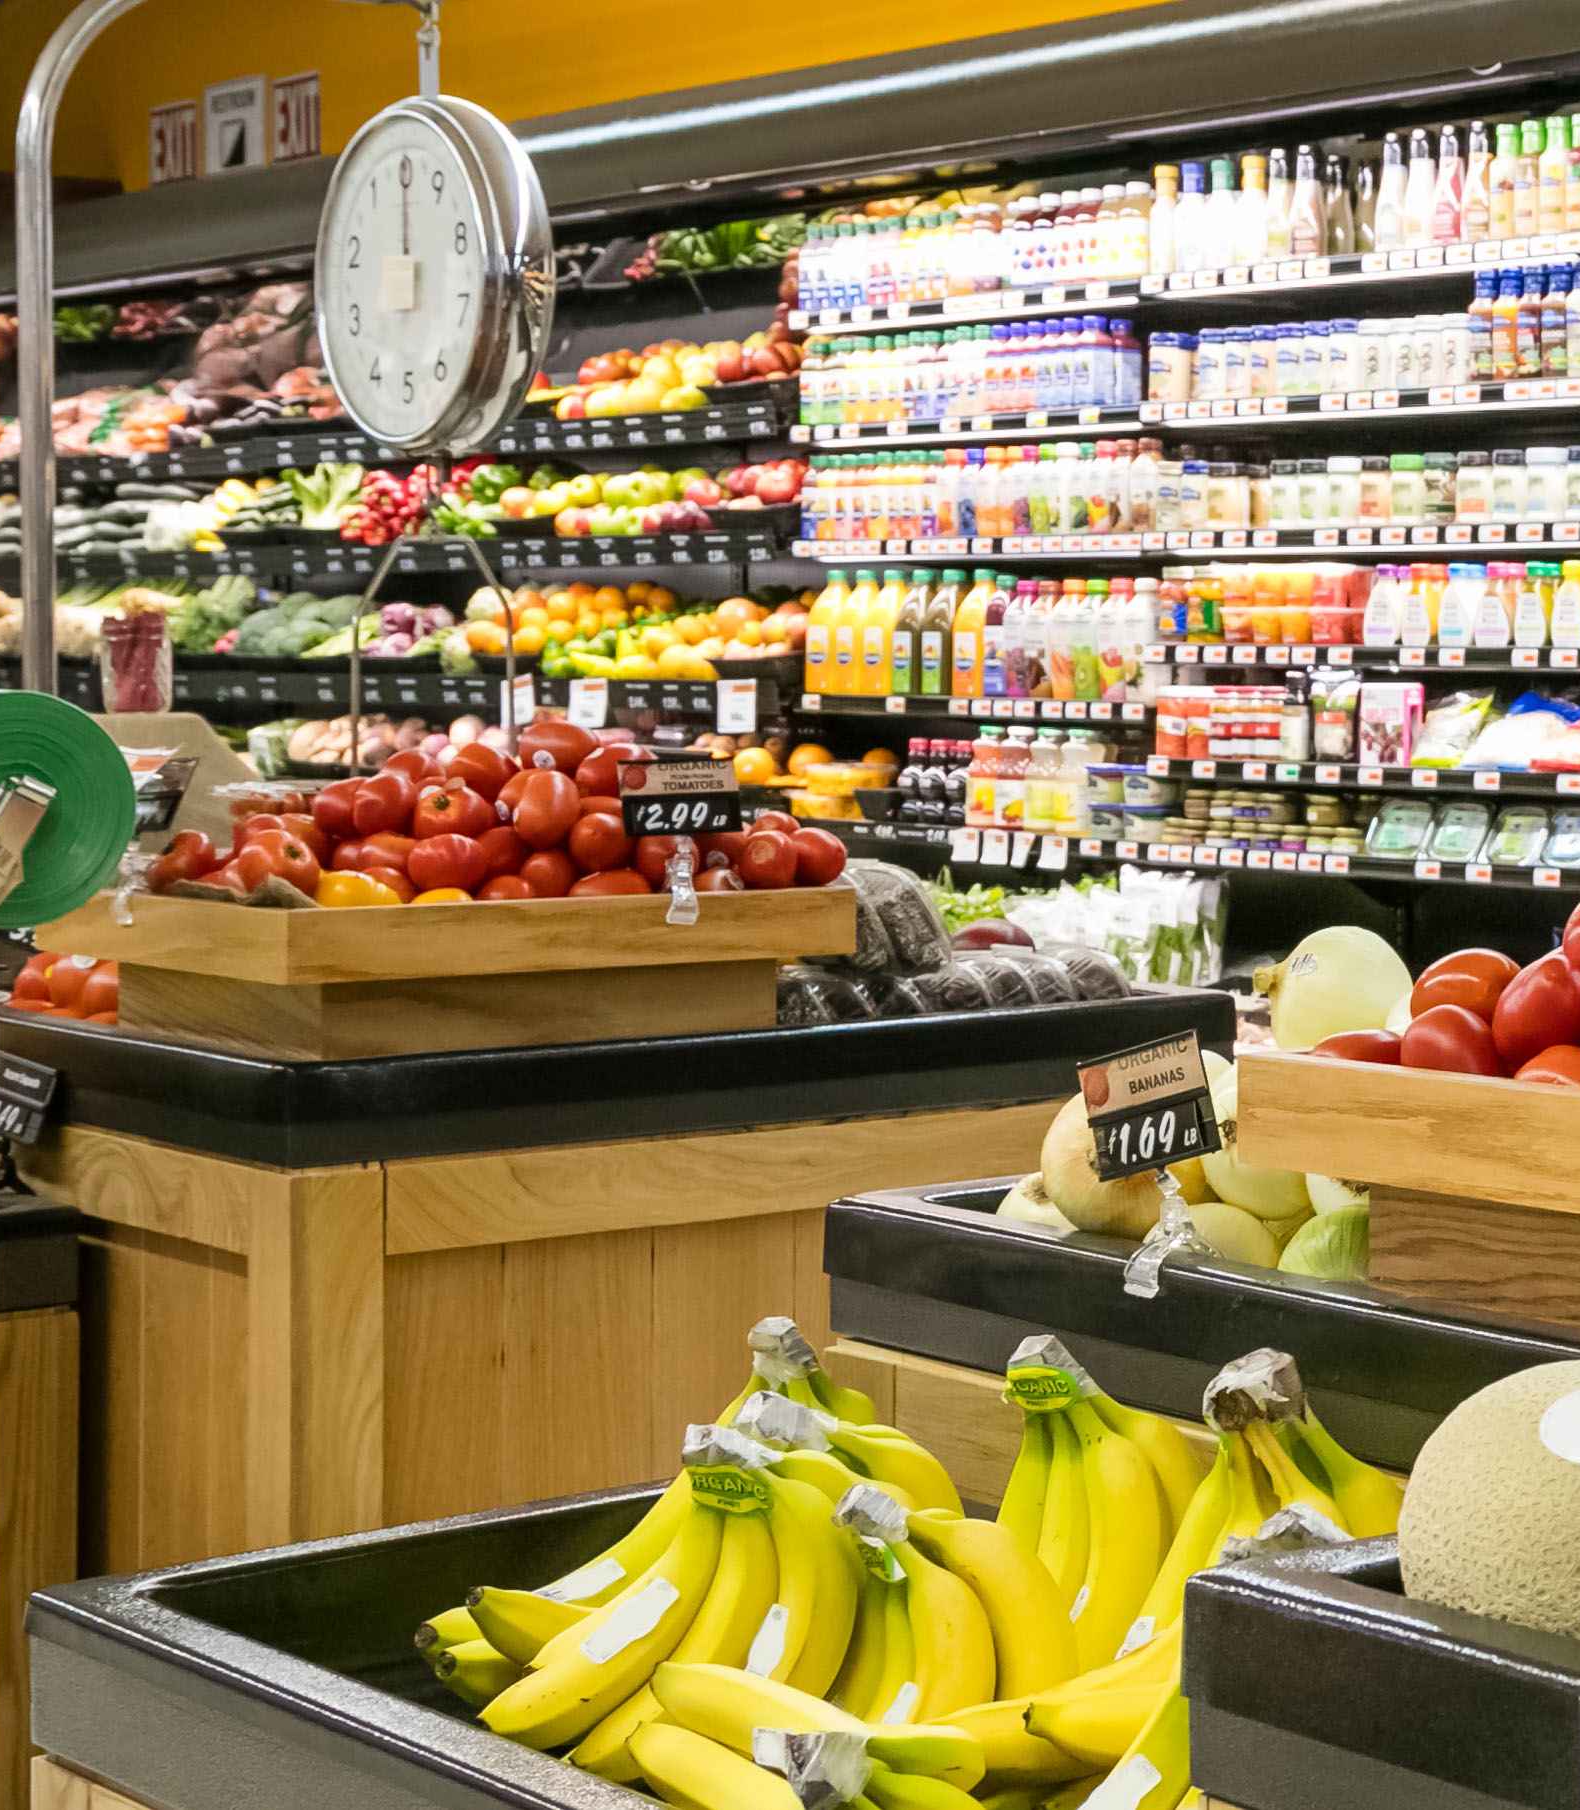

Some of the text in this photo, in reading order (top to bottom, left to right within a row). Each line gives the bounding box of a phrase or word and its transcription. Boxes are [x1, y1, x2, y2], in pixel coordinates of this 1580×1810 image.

[399, 154, 412, 188] 0
[431, 170, 444, 204] 9
[369, 176, 377, 208] 1
[348, 236, 360, 268] 2
[454, 221, 467, 255] 8
[348, 303, 361, 337] 3
[457, 292, 470, 328] 7
[370, 356, 382, 388] 4
[434, 348, 446, 382] 6
[403, 372, 414, 404] 5
[662, 780, 725, 791] TOMATOES
[636, 801, 728, 831] $2.99 LB
[1117, 1039, 1189, 1071] ORGANIC
[1128, 1067, 1186, 1095] BANANAS
[1107, 1110, 1199, 1165] $1.69 LB
